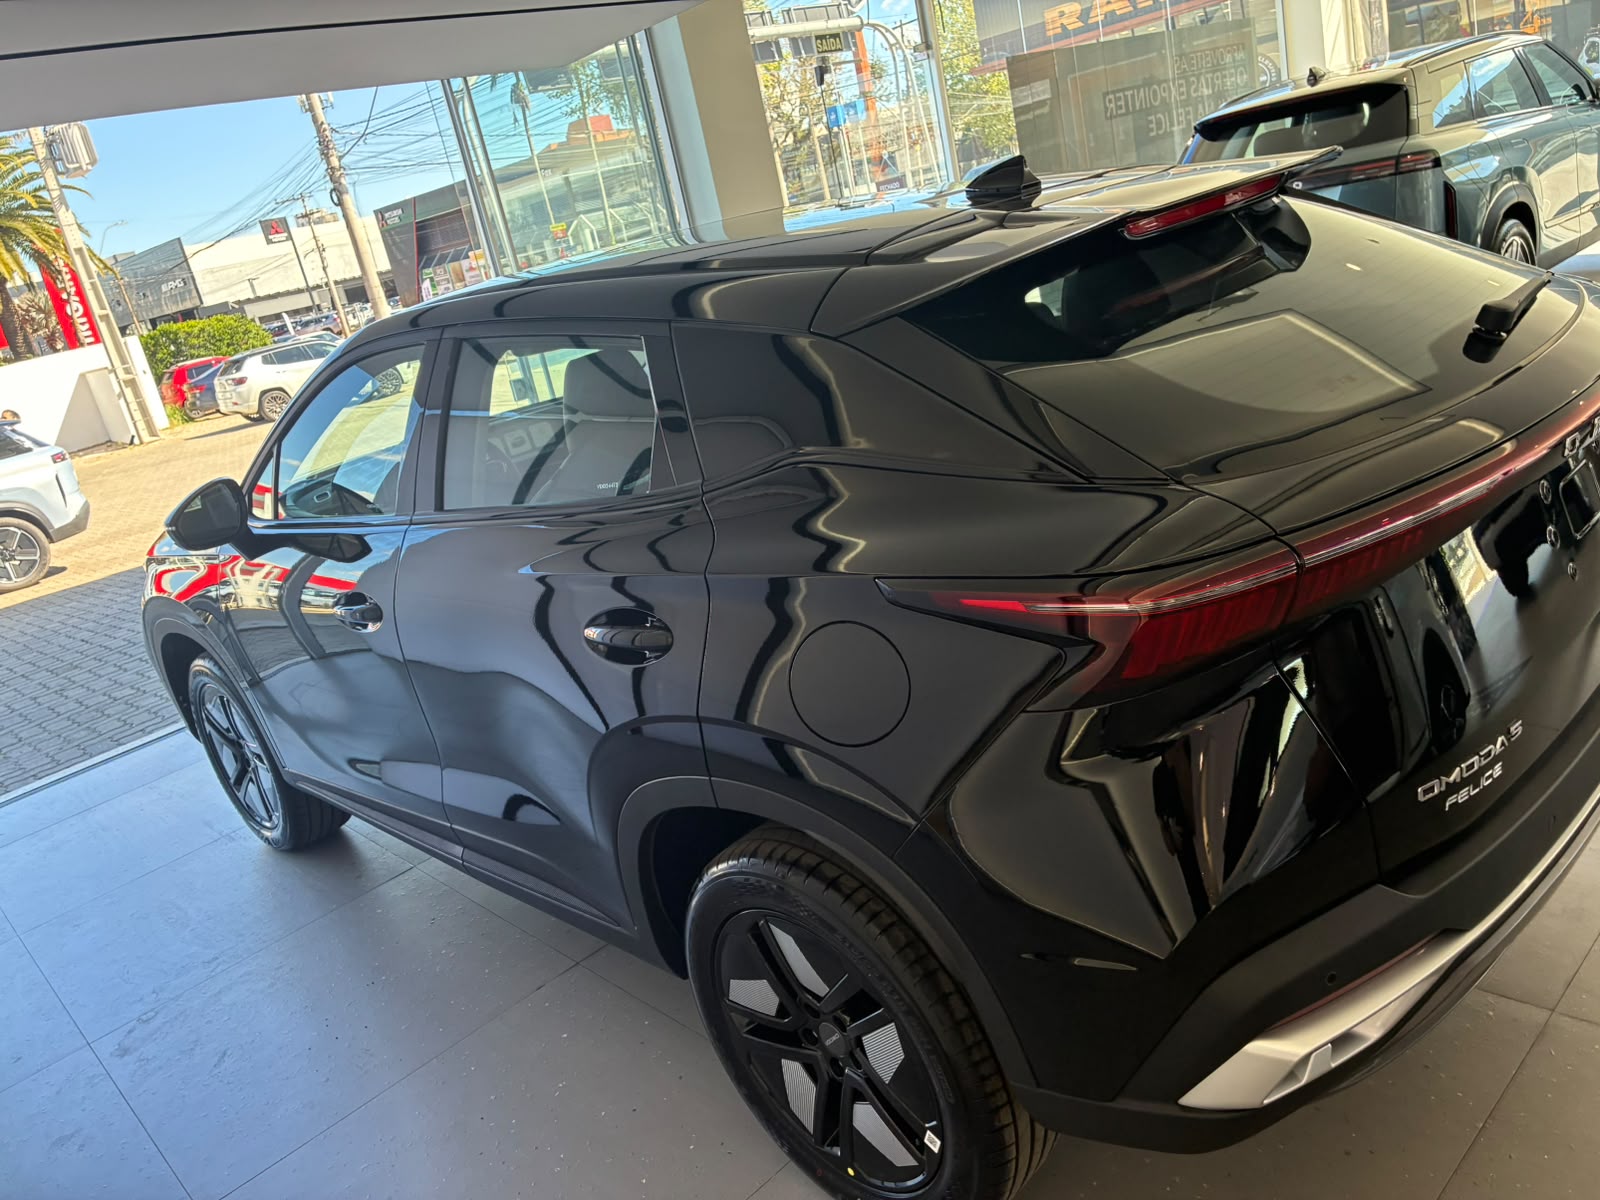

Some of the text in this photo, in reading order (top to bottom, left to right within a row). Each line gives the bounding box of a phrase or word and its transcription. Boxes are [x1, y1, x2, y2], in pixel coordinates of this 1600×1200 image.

[1044, 0, 1154, 36] RA
[816, 35, 842, 52] SAÍDA
[1418, 735, 1508, 802] OMODA
[1446, 761, 1502, 811] FELICE
